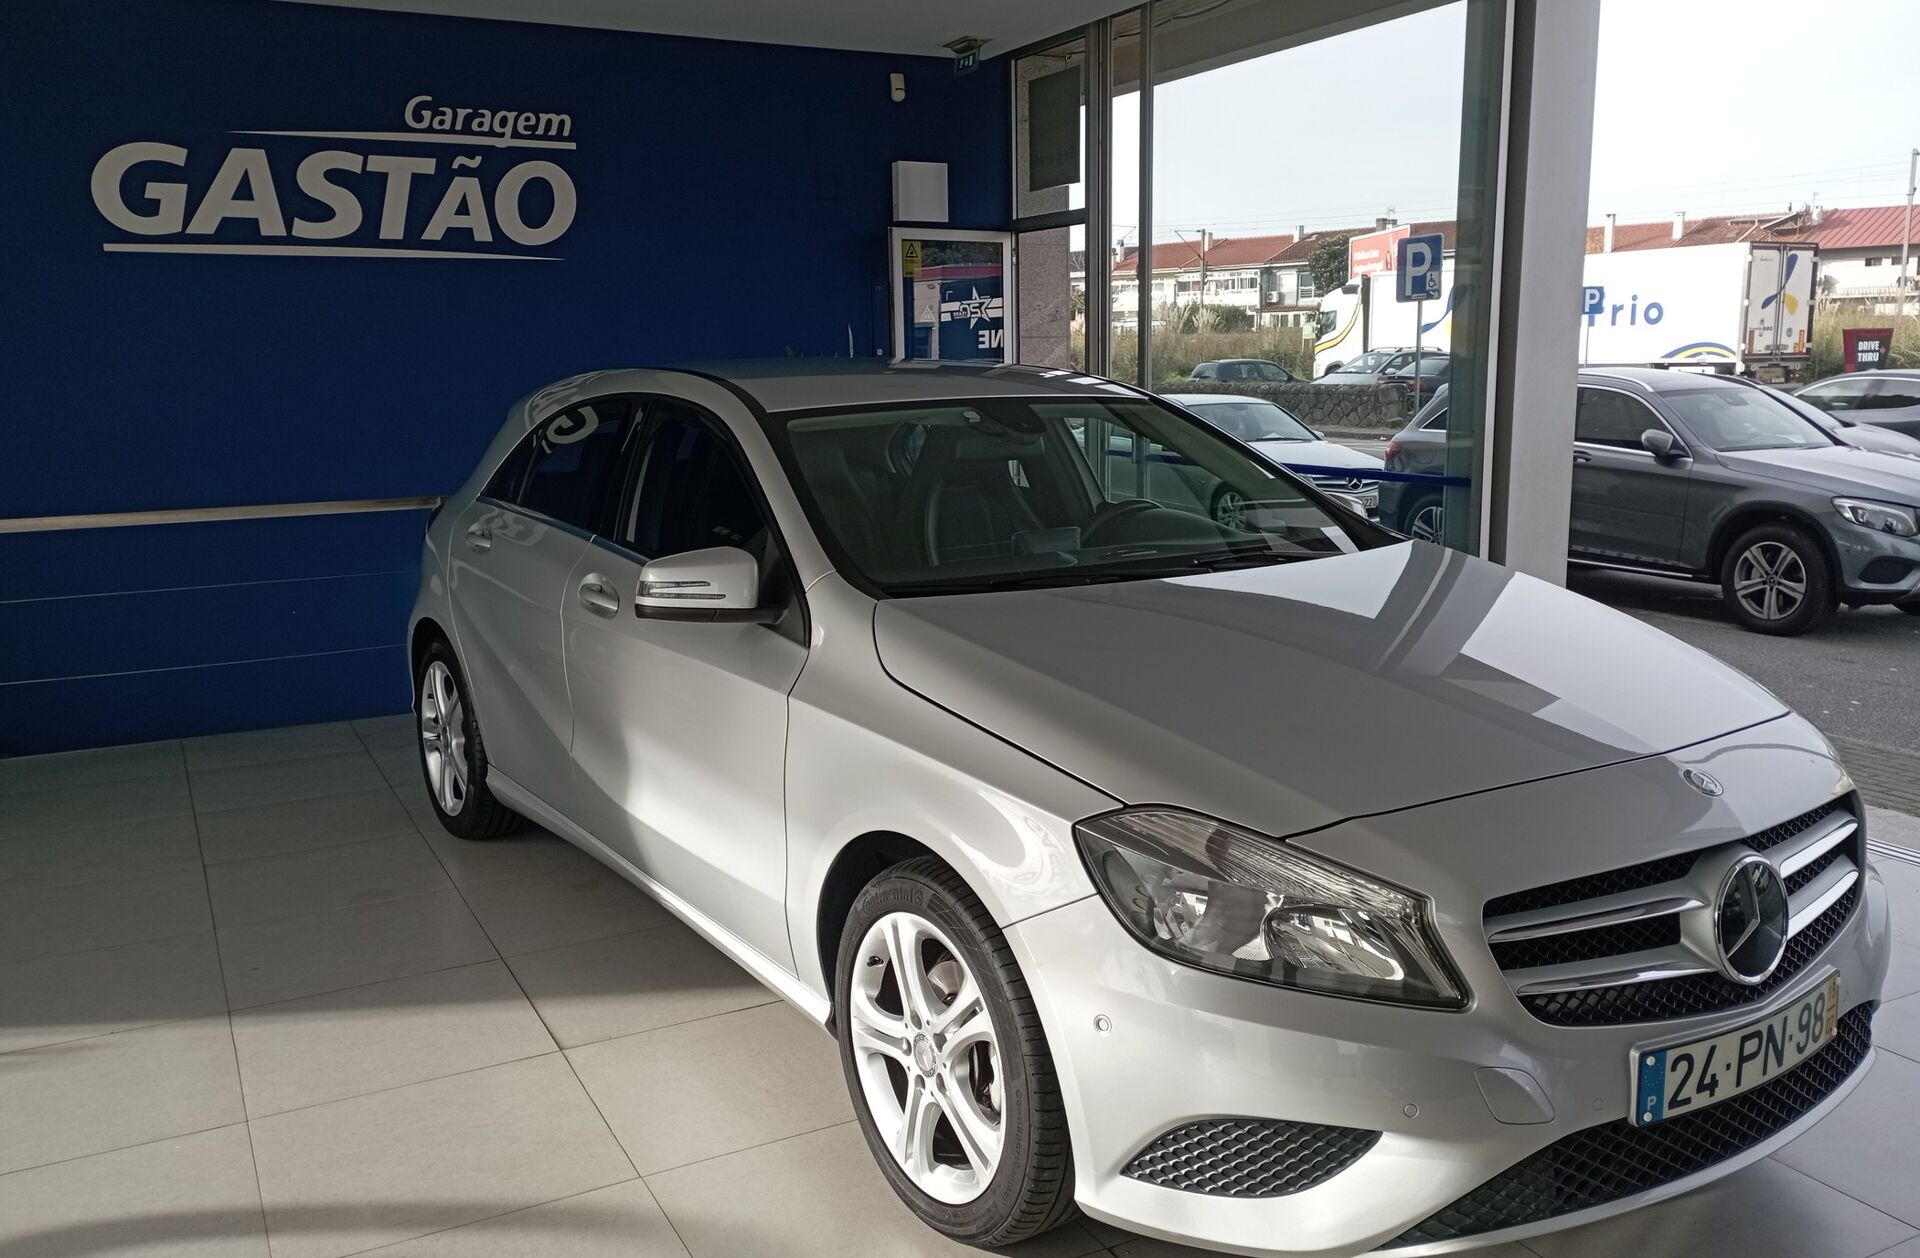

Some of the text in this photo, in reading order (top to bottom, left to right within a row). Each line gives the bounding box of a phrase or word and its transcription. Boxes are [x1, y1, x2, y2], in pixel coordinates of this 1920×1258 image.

[404, 95, 572, 148] Garagem
[90, 141, 577, 246] GASTÃO
[1404, 242, 1432, 297] P
[1584, 288, 1601, 313] P
[1857, 351, 1880, 362] THRU
[1858, 340, 1880, 351] DRIVE
